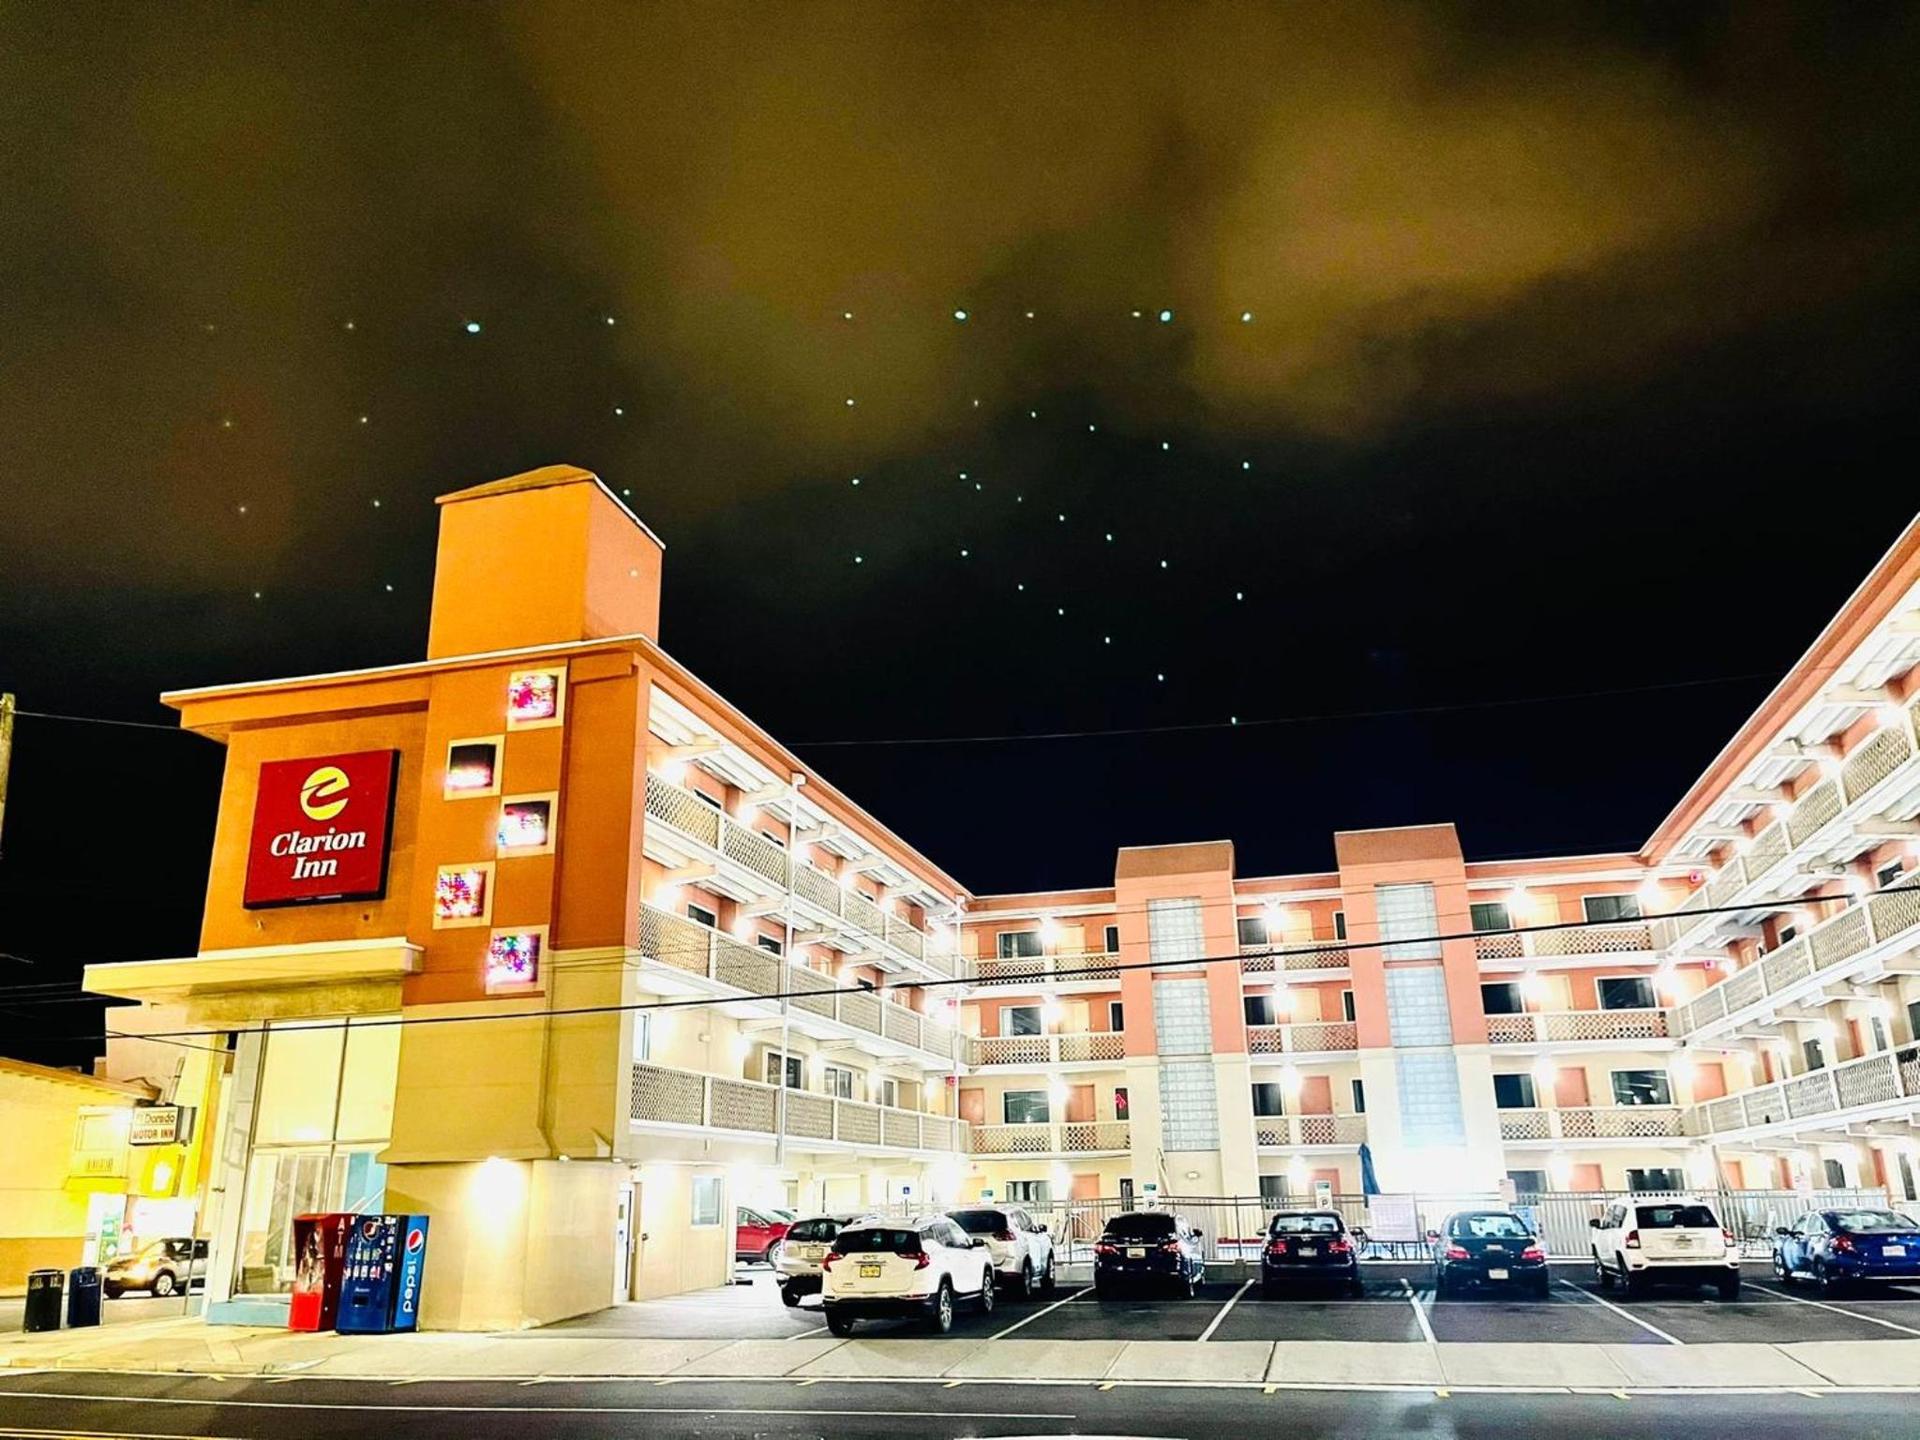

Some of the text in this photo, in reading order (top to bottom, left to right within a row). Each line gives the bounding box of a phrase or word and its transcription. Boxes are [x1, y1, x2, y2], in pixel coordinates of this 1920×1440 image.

[270, 827, 366, 857] Clarion
[291, 856, 338, 880] Inn
[145, 1113, 175, 1123] Dorado
[133, 1129, 174, 1139] MOTOR INN
[403, 1258, 417, 1313] pepsi
